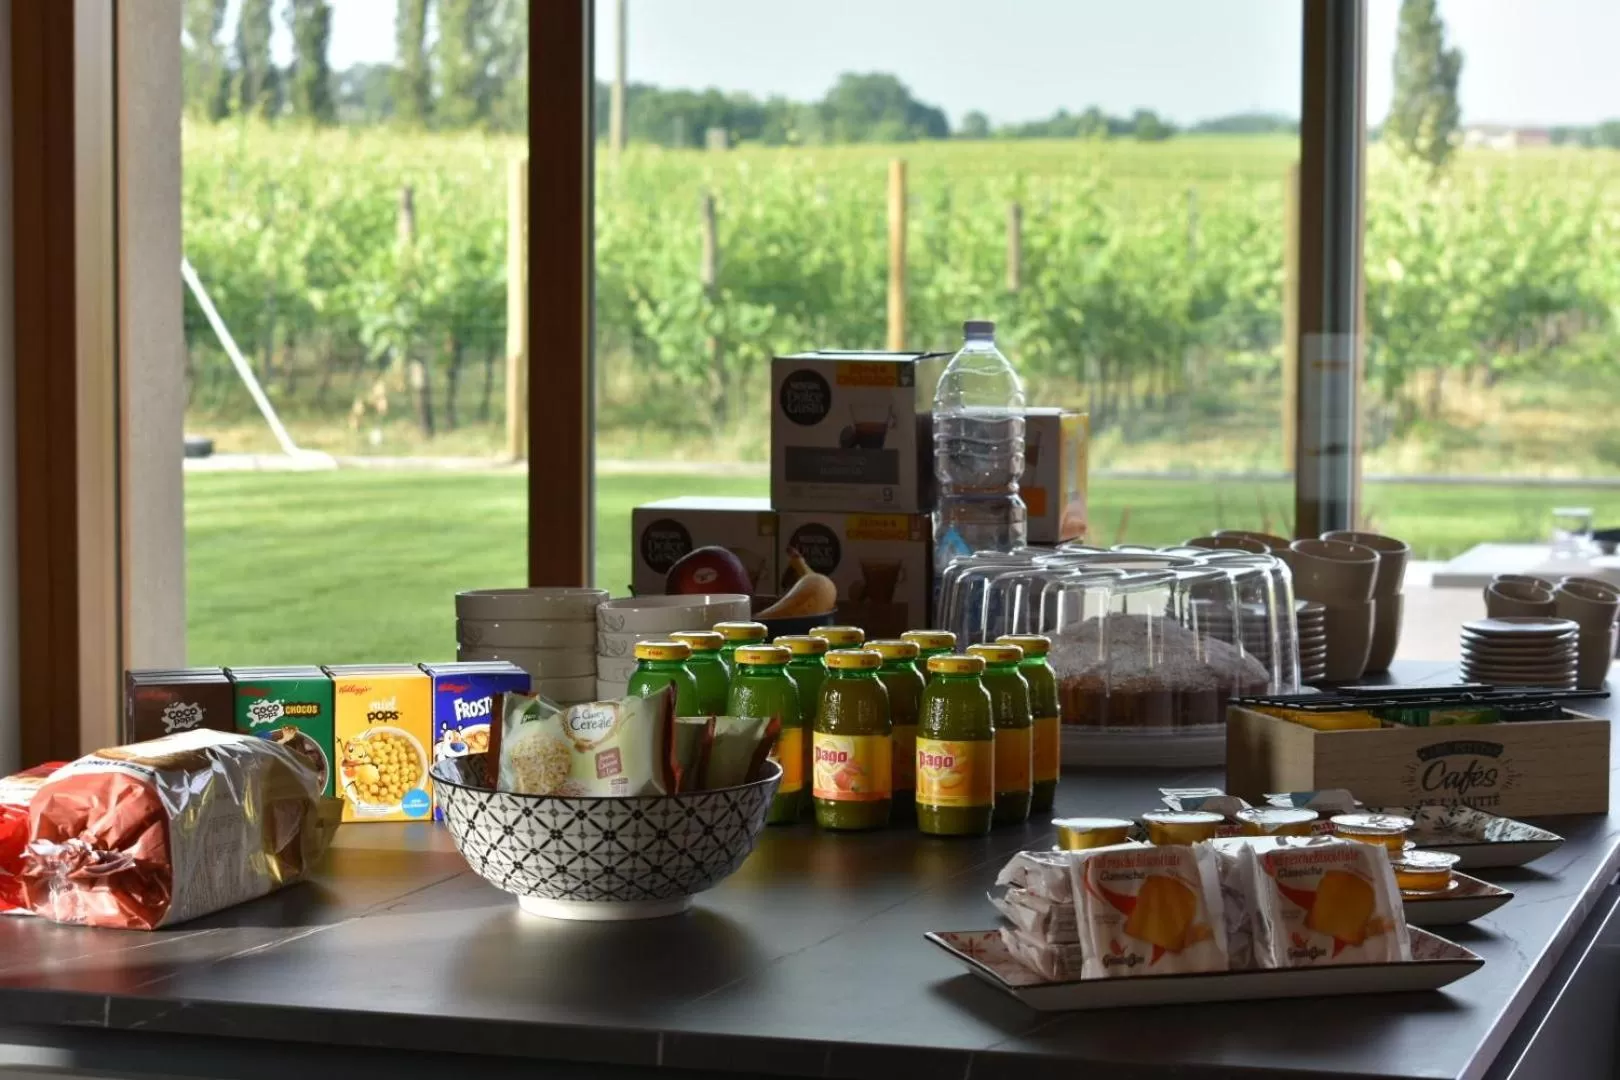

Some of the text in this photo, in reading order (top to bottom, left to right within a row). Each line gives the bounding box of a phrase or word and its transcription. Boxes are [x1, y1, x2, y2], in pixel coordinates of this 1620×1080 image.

[253, 704, 279, 715] COCO
[285, 704, 318, 715] CHOCOS
[173, 715, 197, 727] pops
[257, 711, 279, 722] pops
[367, 711, 400, 724] pops
[815, 746, 848, 764] pago
[919, 751, 954, 769] pago
[1422, 759, 1498, 795] Cafés
